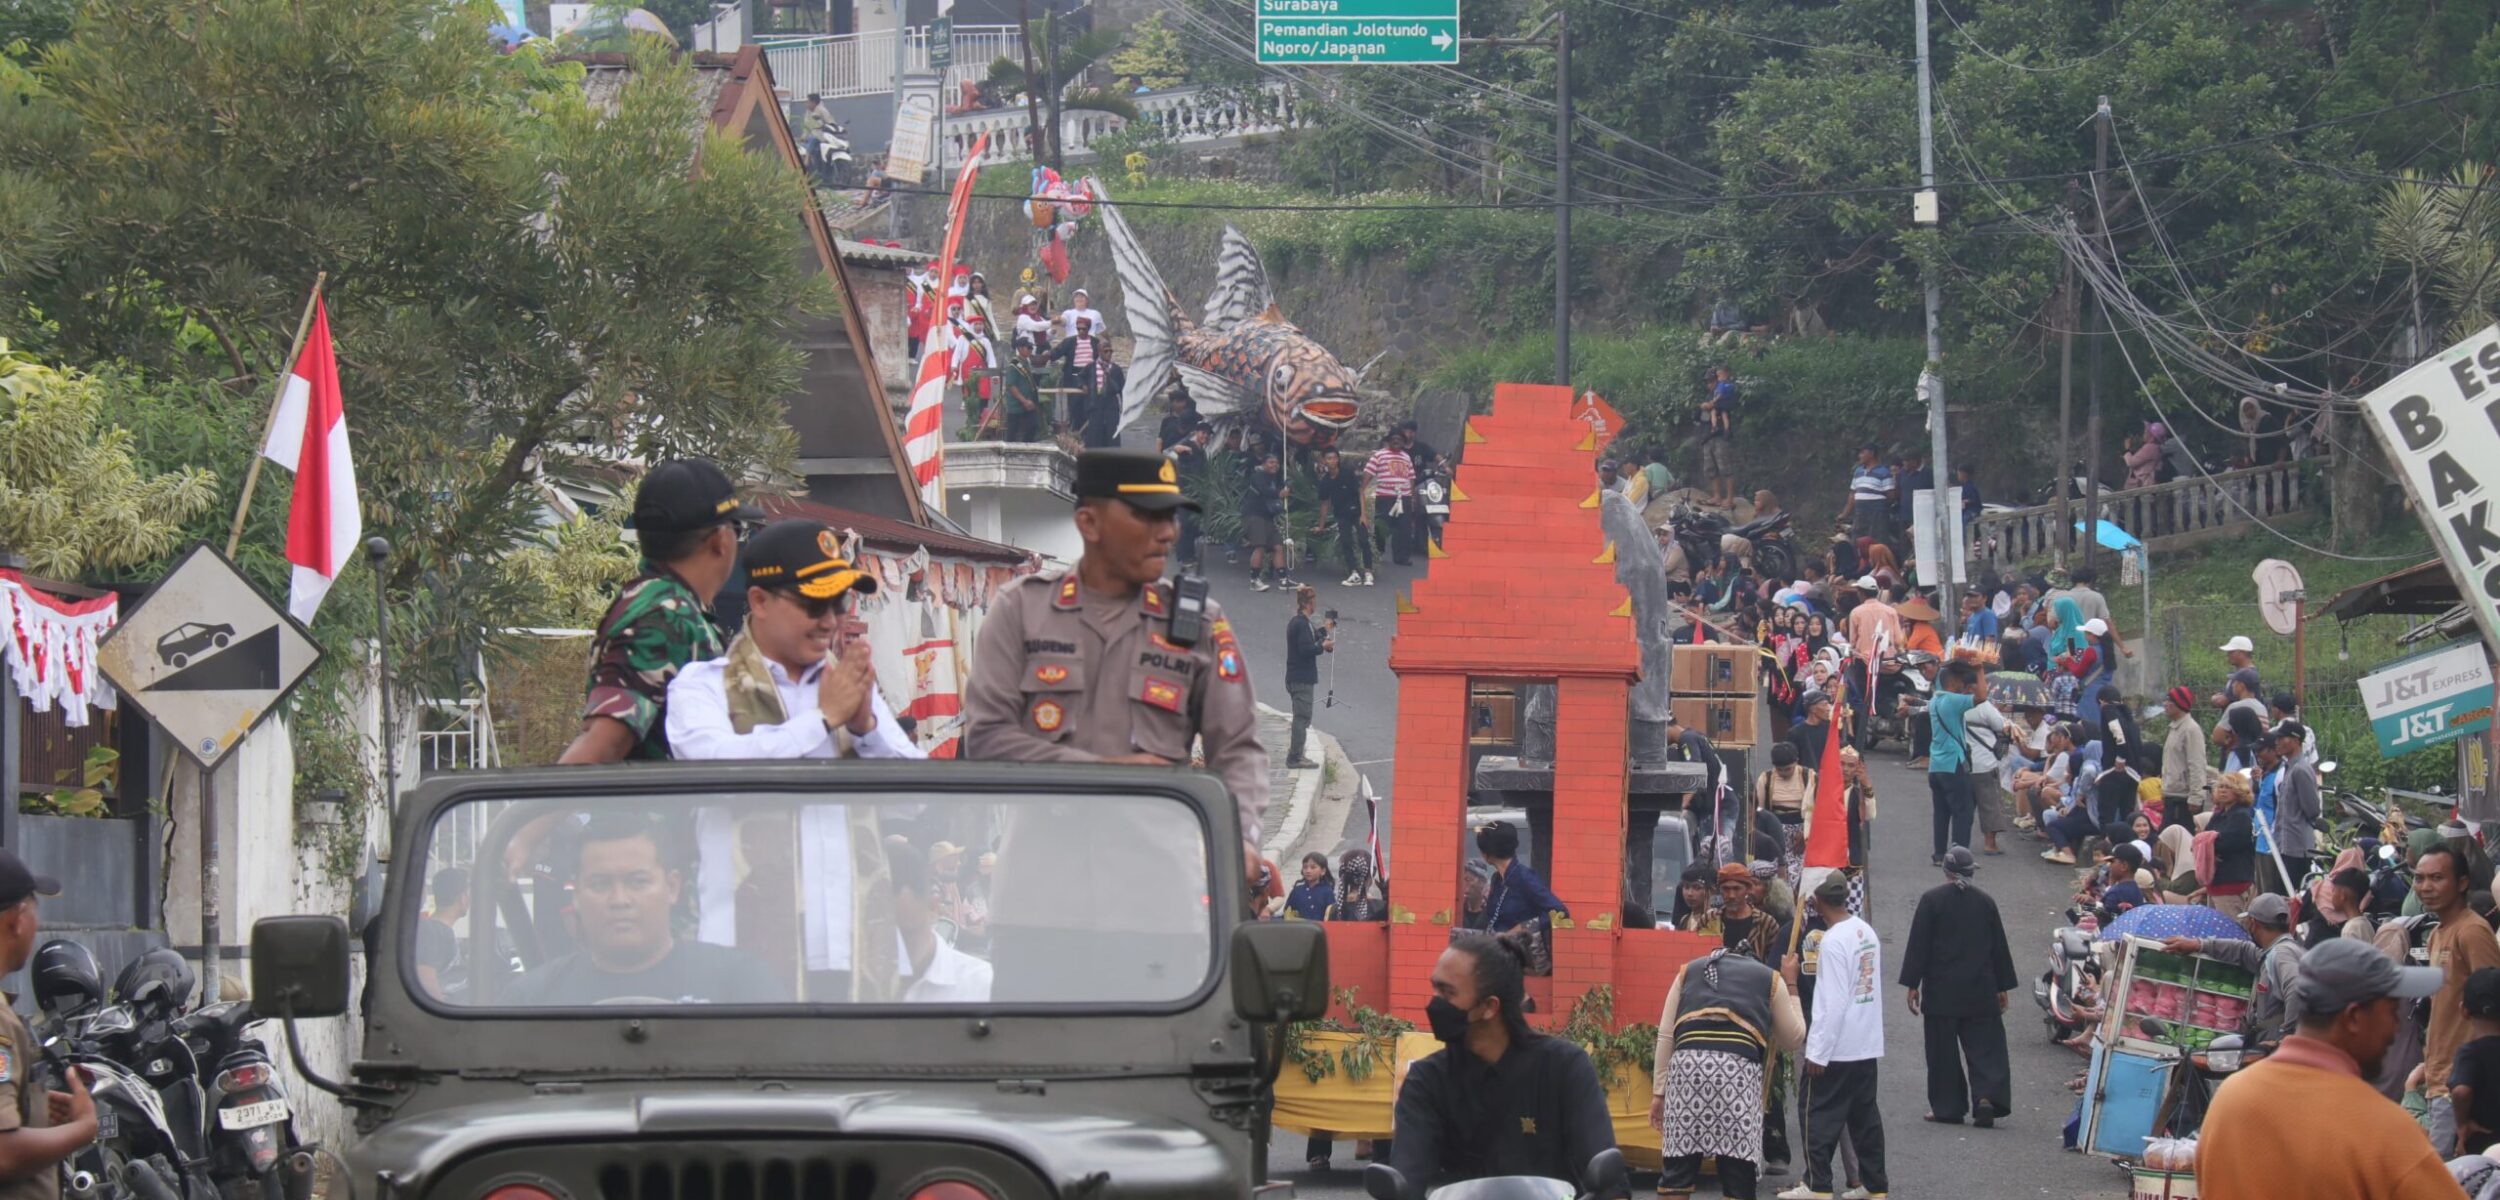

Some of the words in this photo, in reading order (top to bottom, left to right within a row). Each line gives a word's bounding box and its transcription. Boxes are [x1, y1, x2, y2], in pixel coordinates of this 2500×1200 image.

[1263, 0, 1338, 14] Surabaya
[1263, 23, 1347, 36] Pemandian
[1353, 23, 1427, 37] Jolotundo
[1140, 653, 1191, 675] POLRI
[2376, 666, 2438, 708] J&T
[2432, 667, 2482, 691] EXPRESS
[2392, 702, 2454, 745] J&T
[236, 1105, 261, 1119] 2371
